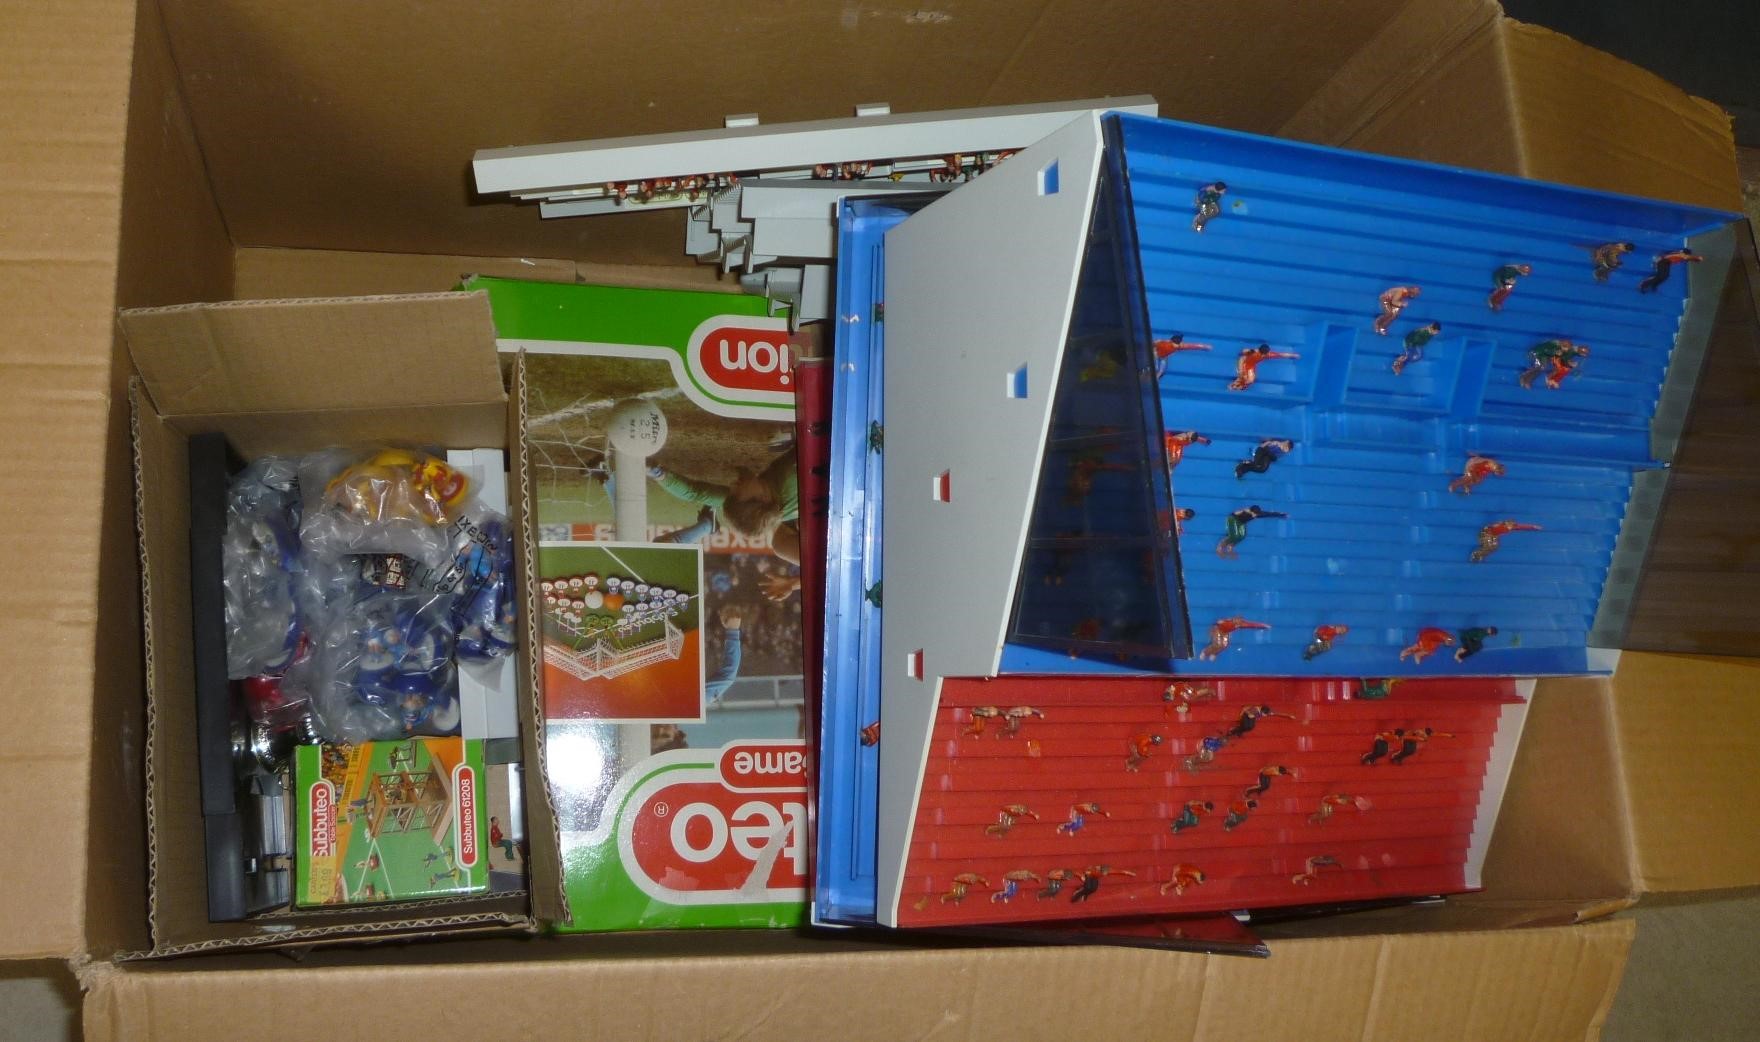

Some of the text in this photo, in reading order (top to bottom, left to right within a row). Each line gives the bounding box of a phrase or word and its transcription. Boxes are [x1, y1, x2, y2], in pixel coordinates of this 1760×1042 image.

[733, 751, 807, 775] ame
[313, 788, 328, 856] Subbuteo
[461, 778, 473, 854] Subbuteo 61208
